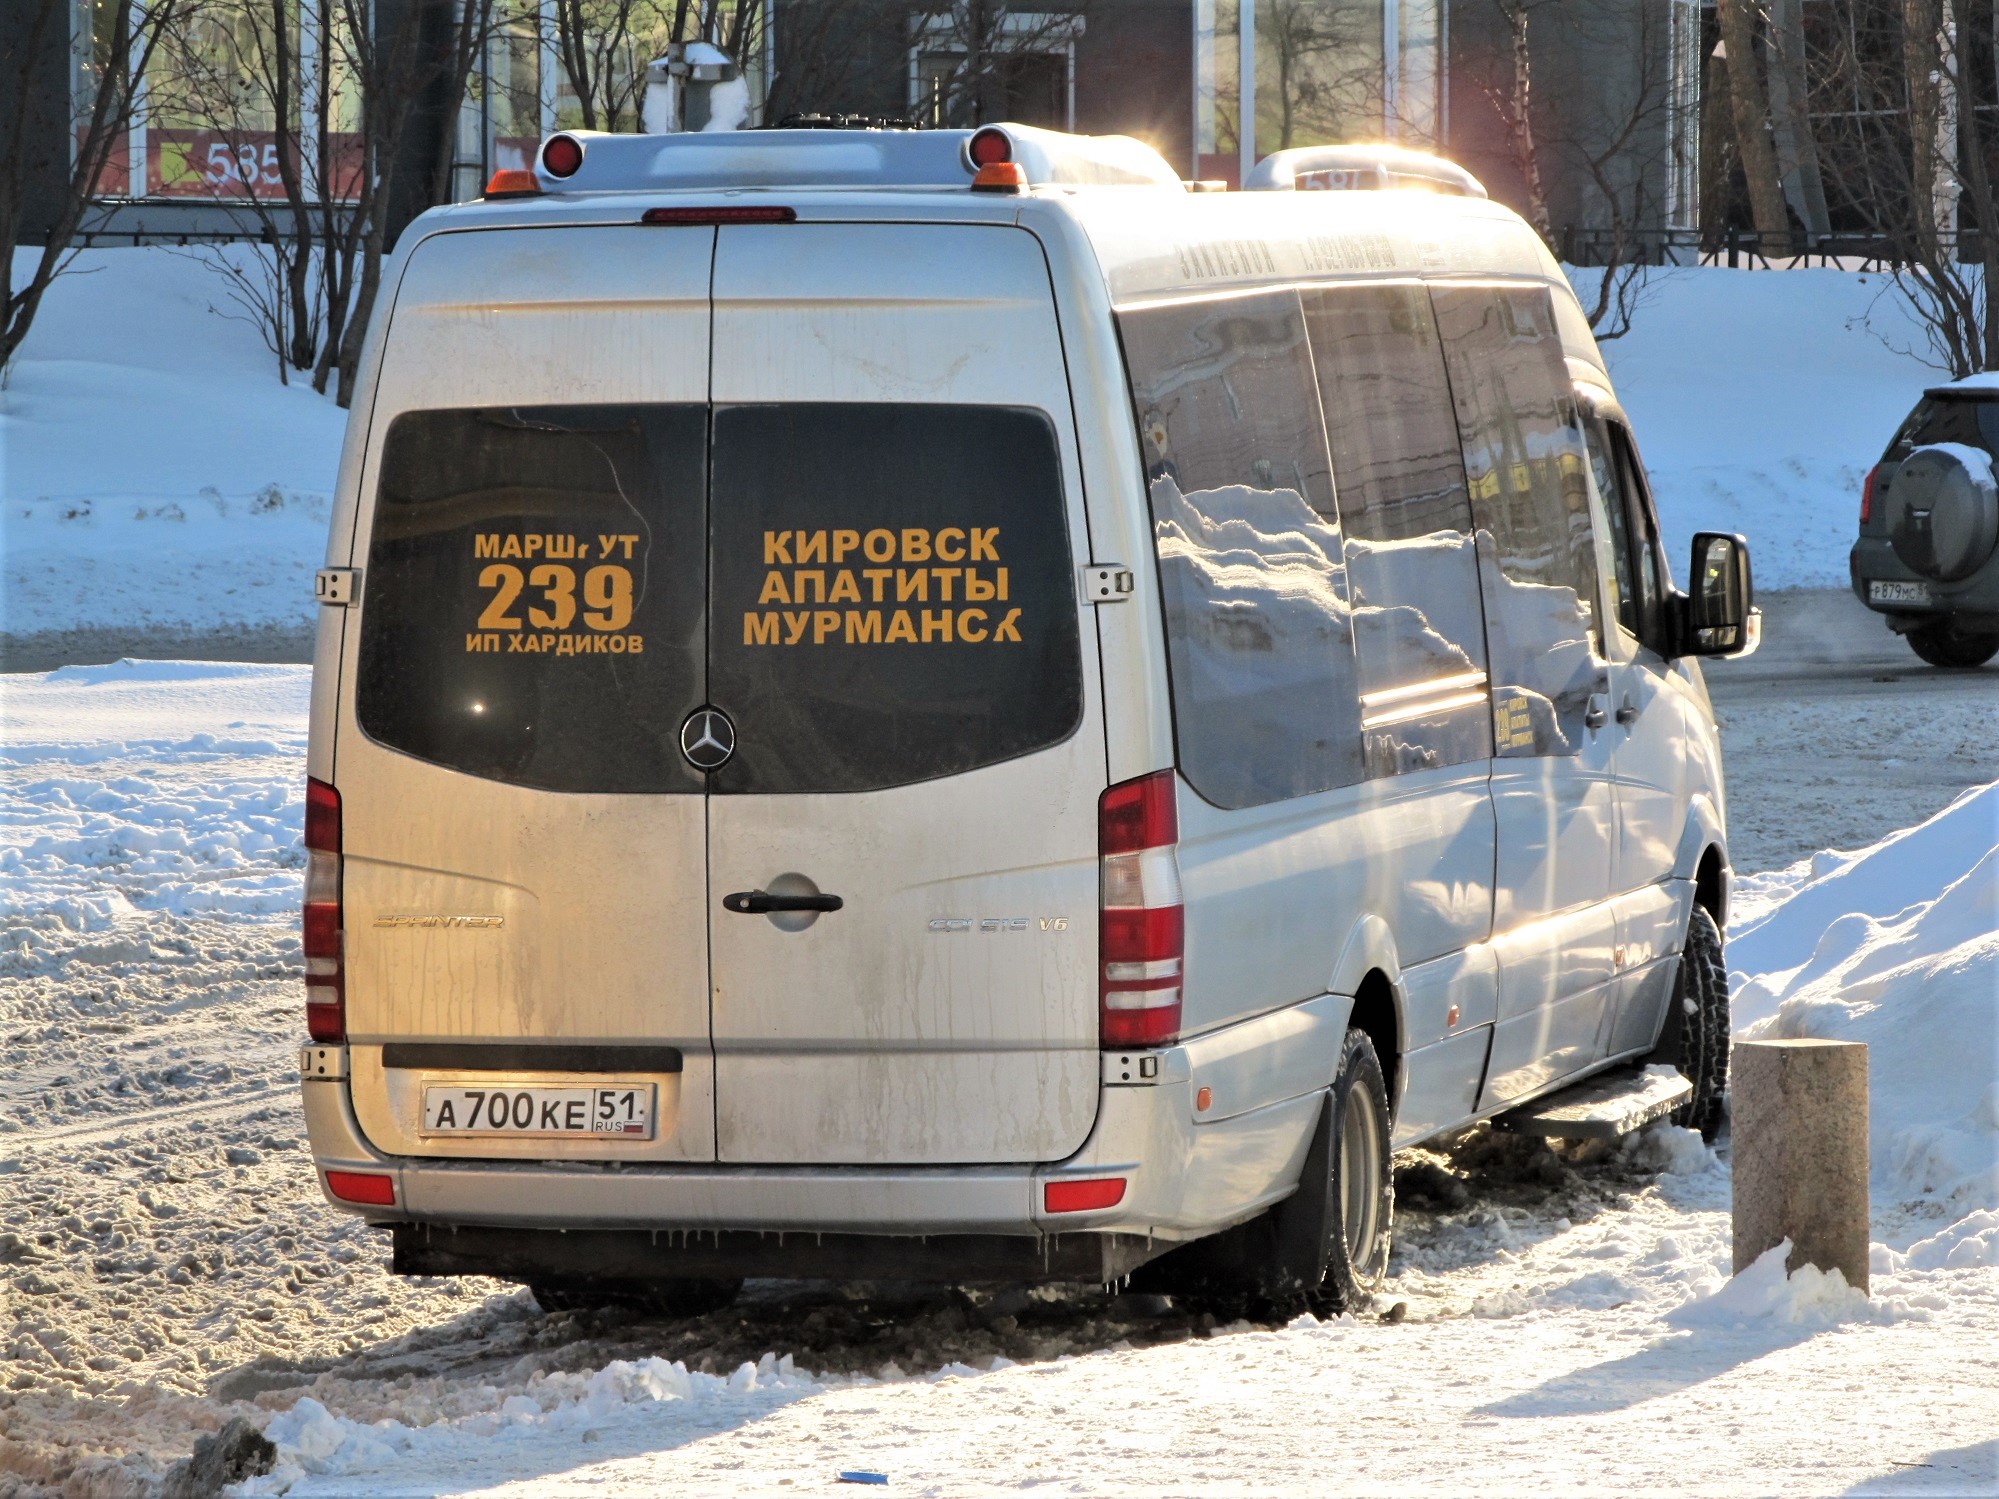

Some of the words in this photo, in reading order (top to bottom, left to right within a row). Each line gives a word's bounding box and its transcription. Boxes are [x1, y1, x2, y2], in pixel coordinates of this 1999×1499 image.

[206, 143, 281, 184] 585
[763, 527, 1000, 564] КИРОВСК
[477, 563, 633, 631] 239
[758, 567, 1009, 604] АПАТИТЫ
[743, 608, 1023, 645] МУРМАНСК
[466, 633, 499, 652] ИП
[508, 634, 644, 656] ХАРДИКОВ
[373, 915, 504, 928] SPRINTER
[1039, 916, 1069, 932] V6
[598, 1091, 635, 1120] 51
[596, 1121, 622, 1132] RUS
